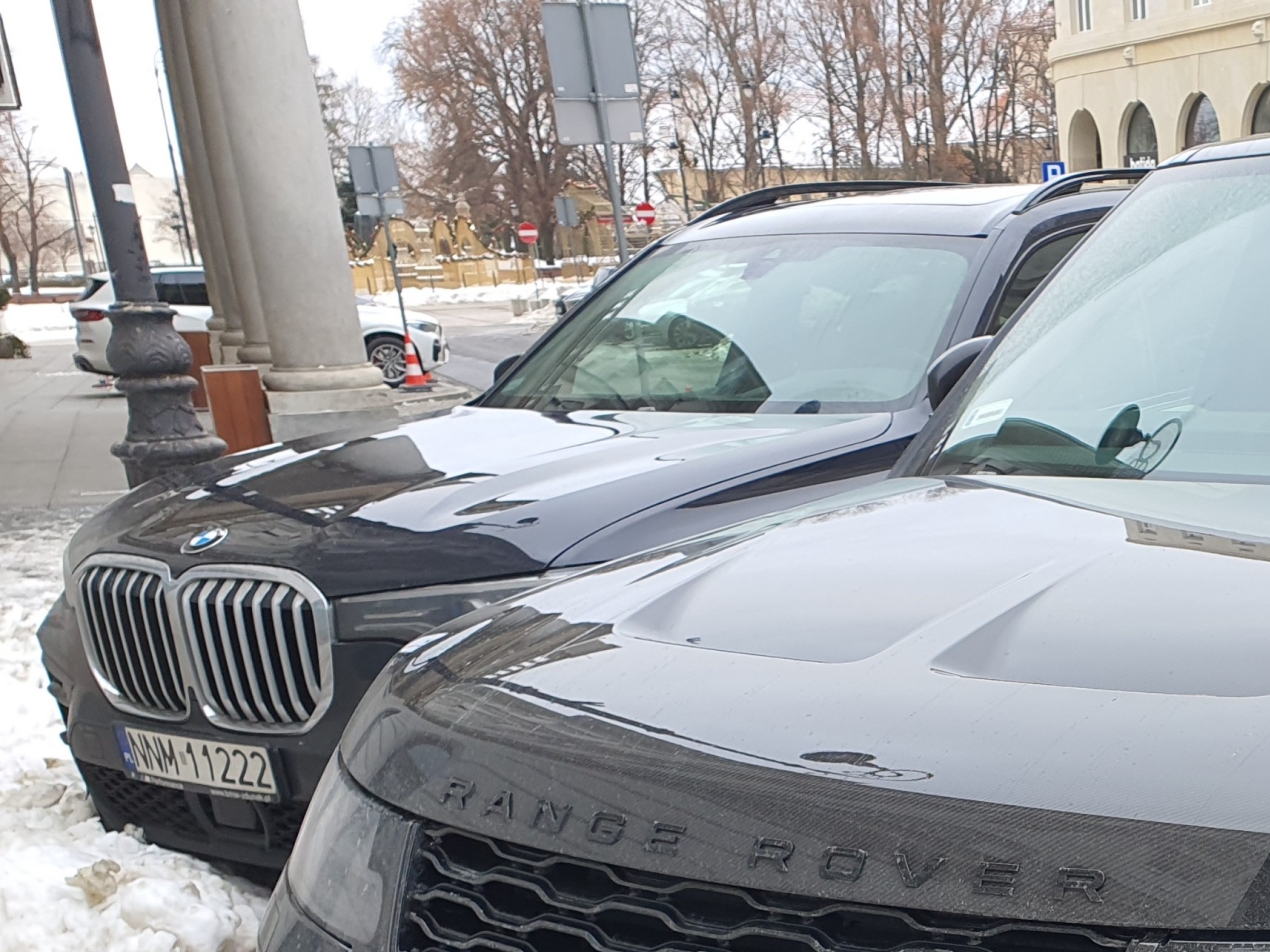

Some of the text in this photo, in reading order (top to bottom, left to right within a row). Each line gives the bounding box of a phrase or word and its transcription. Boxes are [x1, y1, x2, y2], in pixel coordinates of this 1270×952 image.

[128, 732, 272, 789] NNM 11222
[439, 776, 1106, 903] RANGE ROVER
